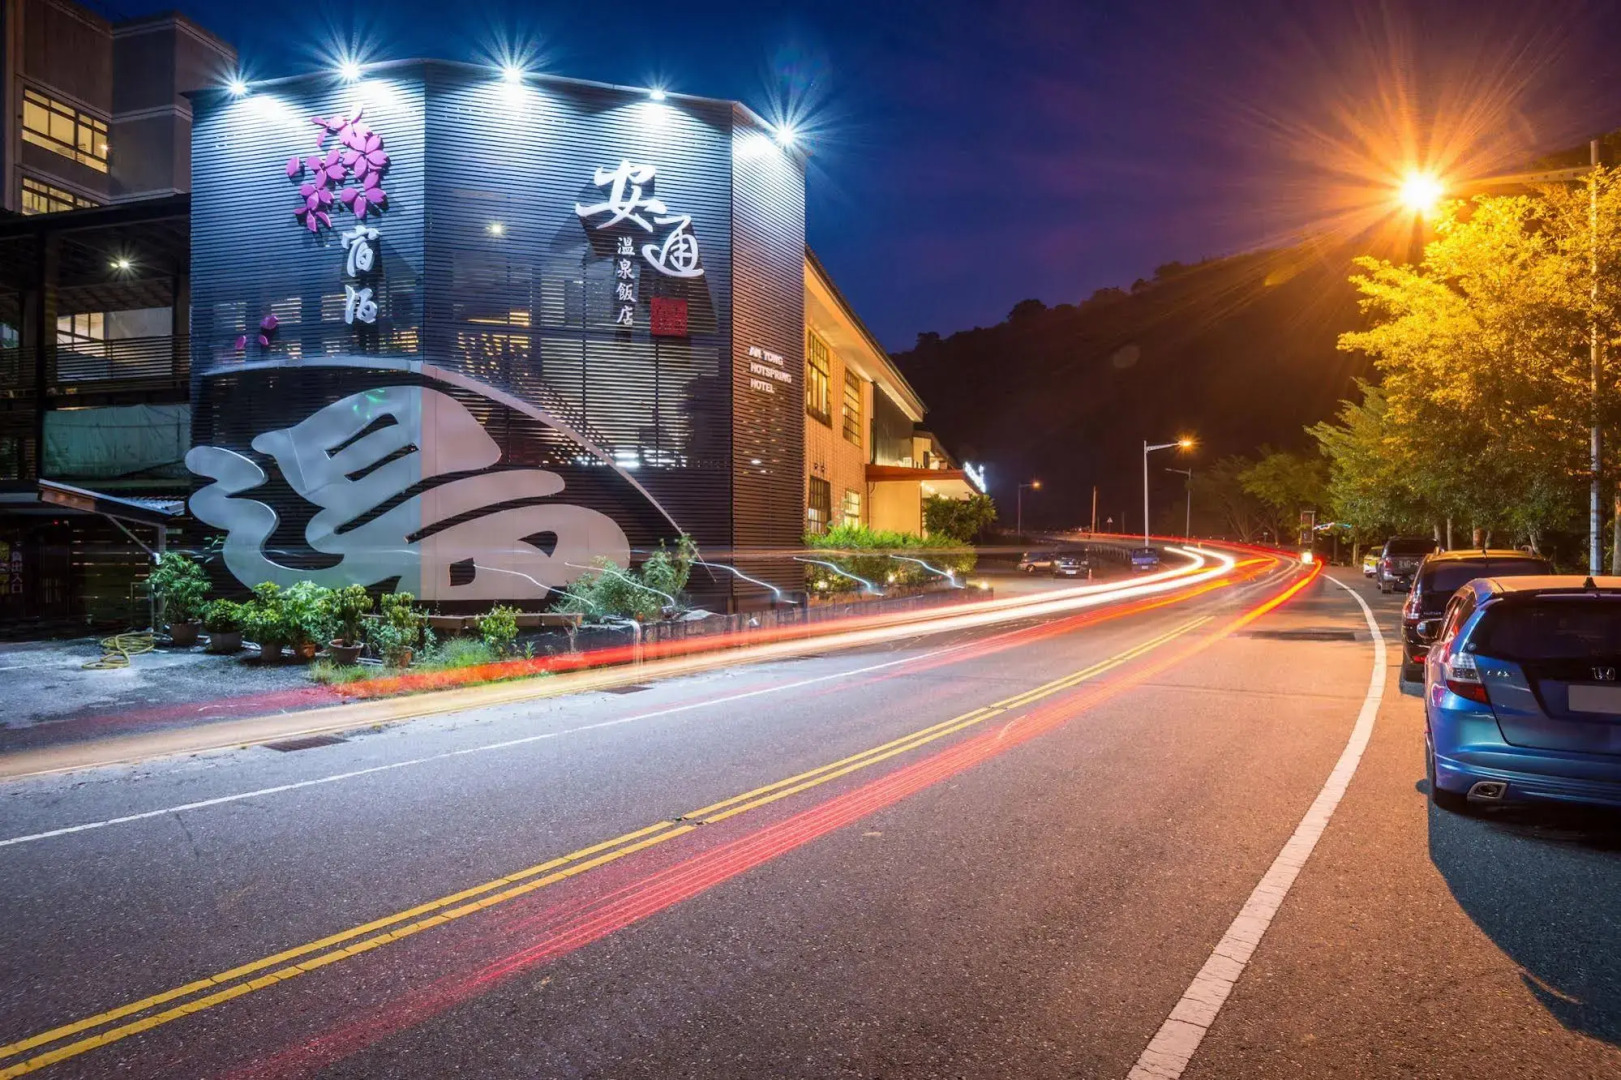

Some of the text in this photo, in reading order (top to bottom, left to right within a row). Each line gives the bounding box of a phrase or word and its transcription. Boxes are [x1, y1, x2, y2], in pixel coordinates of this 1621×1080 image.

[575, 158, 704, 278] 安通
[764, 351, 784, 365] TONG
[750, 361, 792, 383] HOTSPRING
[750, 378, 775, 394] HOTEL
